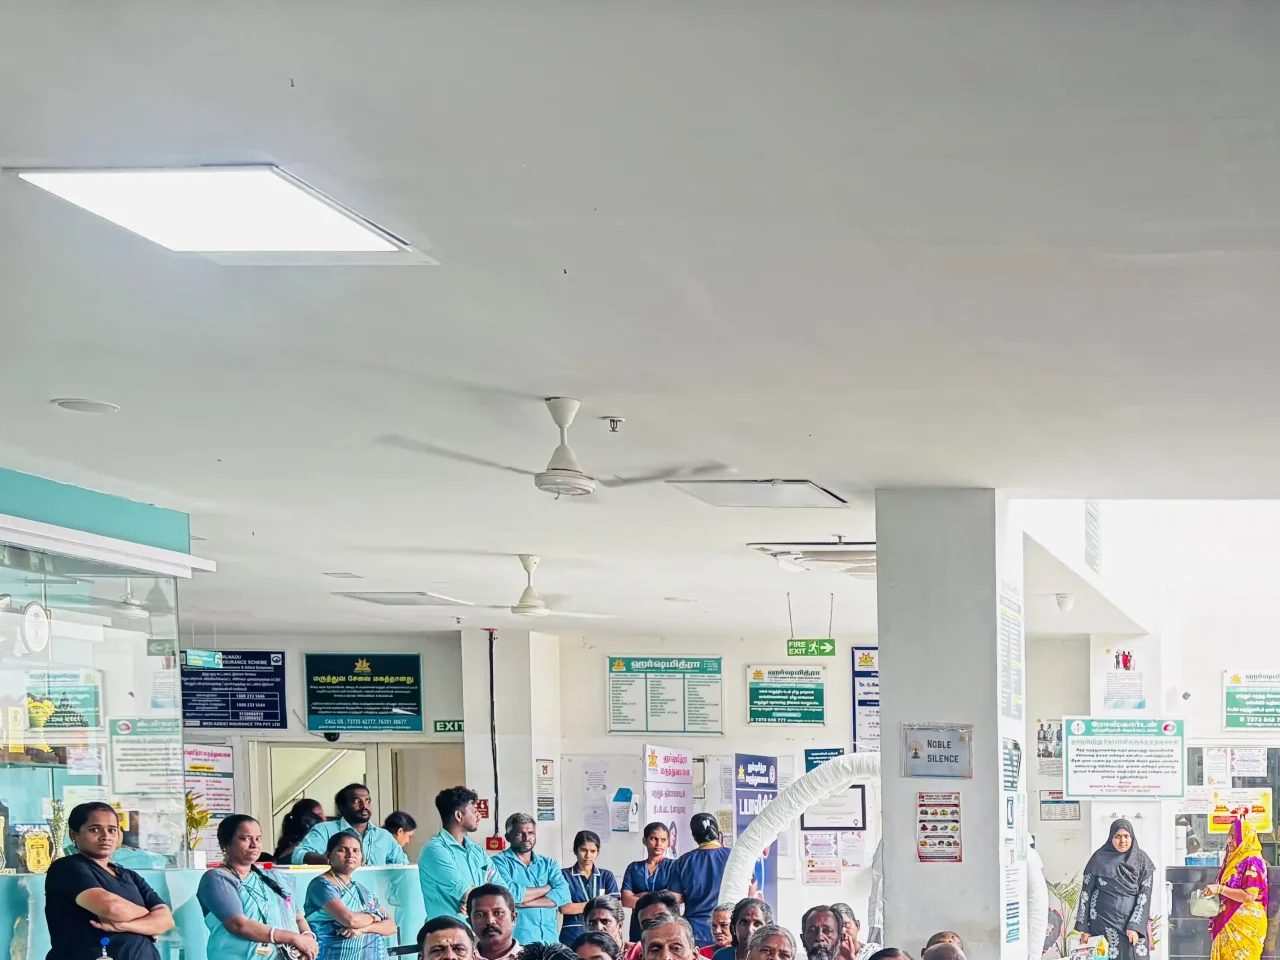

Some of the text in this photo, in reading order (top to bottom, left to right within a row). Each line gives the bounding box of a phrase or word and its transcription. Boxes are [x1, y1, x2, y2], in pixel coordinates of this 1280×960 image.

[631, 659, 701, 669] ஹர்ஷமித்ரா
[313, 676, 346, 684] மருத்துவ
[373, 676, 414, 684] மகத்தானது
[436, 722, 464, 731] EXIT
[927, 739, 952, 749] NOBLE
[927, 754, 959, 763] SILENCE
